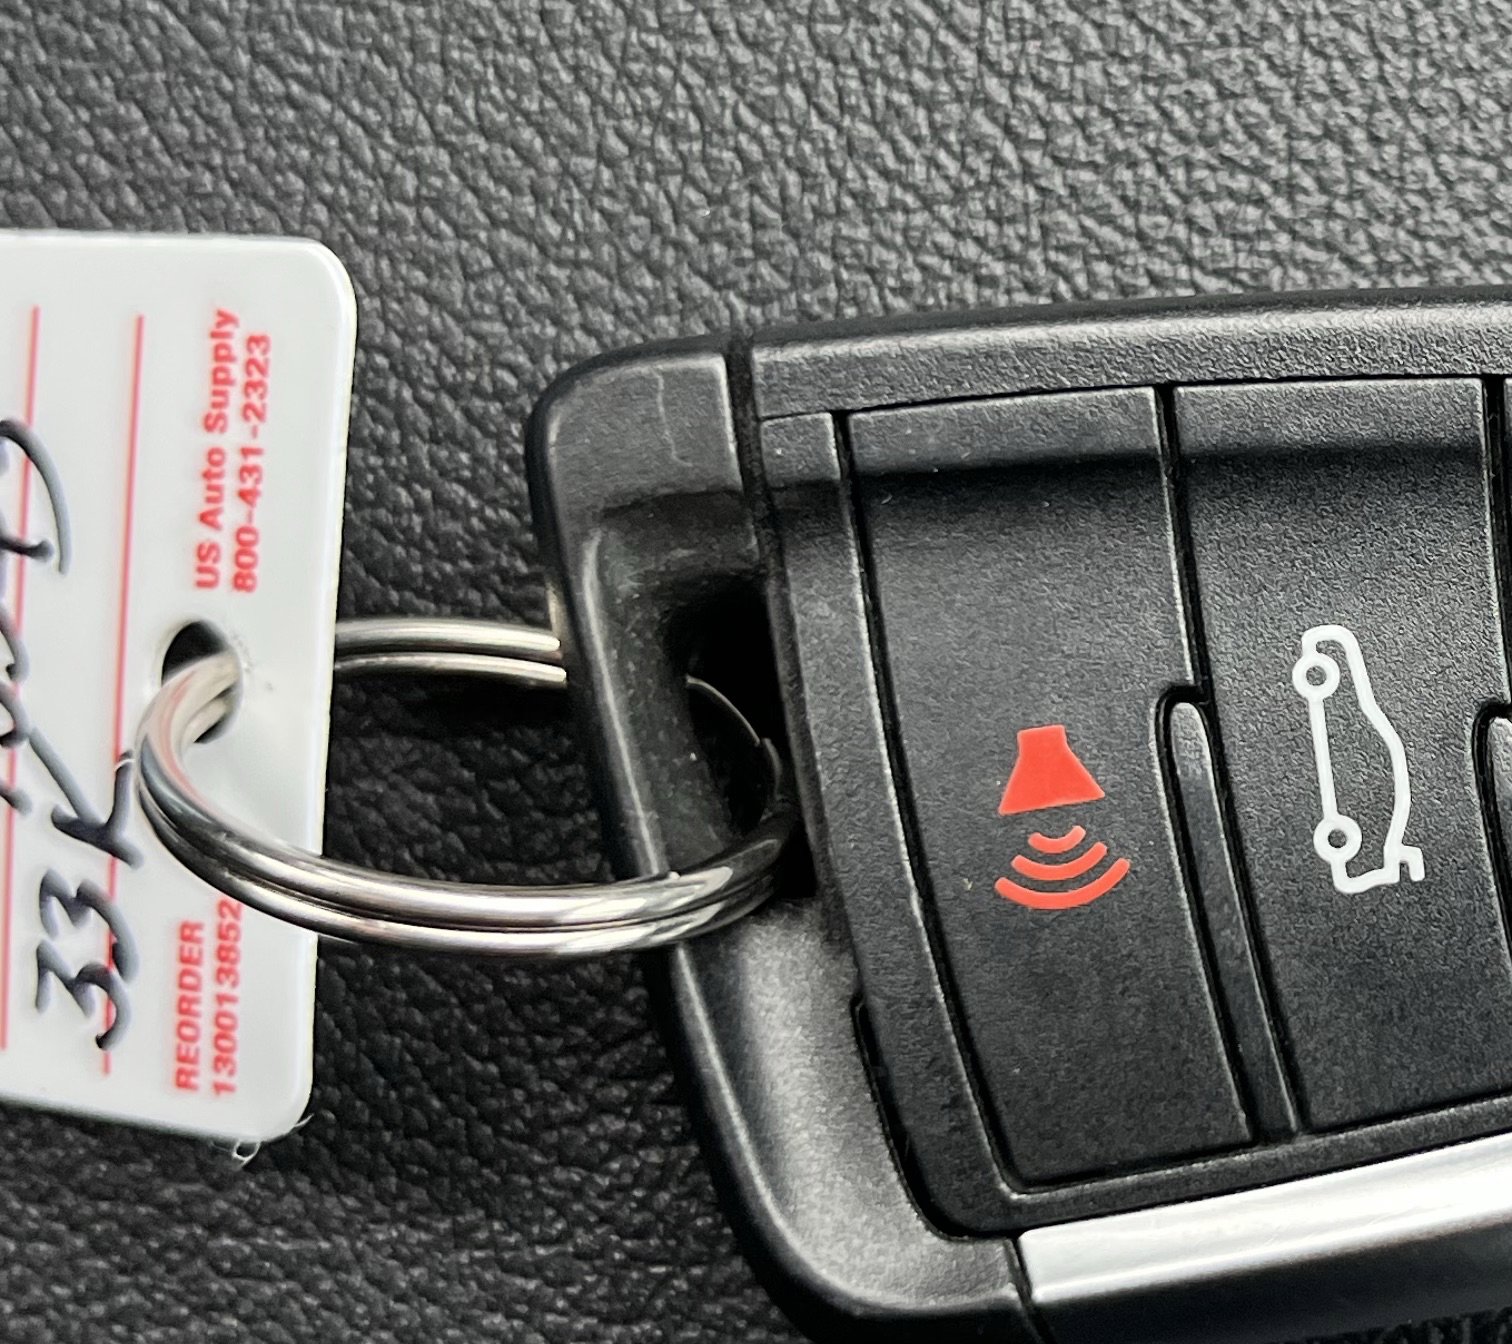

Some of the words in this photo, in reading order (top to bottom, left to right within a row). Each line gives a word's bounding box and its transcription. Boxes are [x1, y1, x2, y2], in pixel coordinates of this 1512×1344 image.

[203, 308, 240, 434] Supply
[199, 446, 228, 531] Auto
[232, 334, 272, 593] 800-431-2323
[194, 542, 220, 589] US
[174, 920, 205, 1092] REORDER
[211, 898, 243, 1096] 130013852
